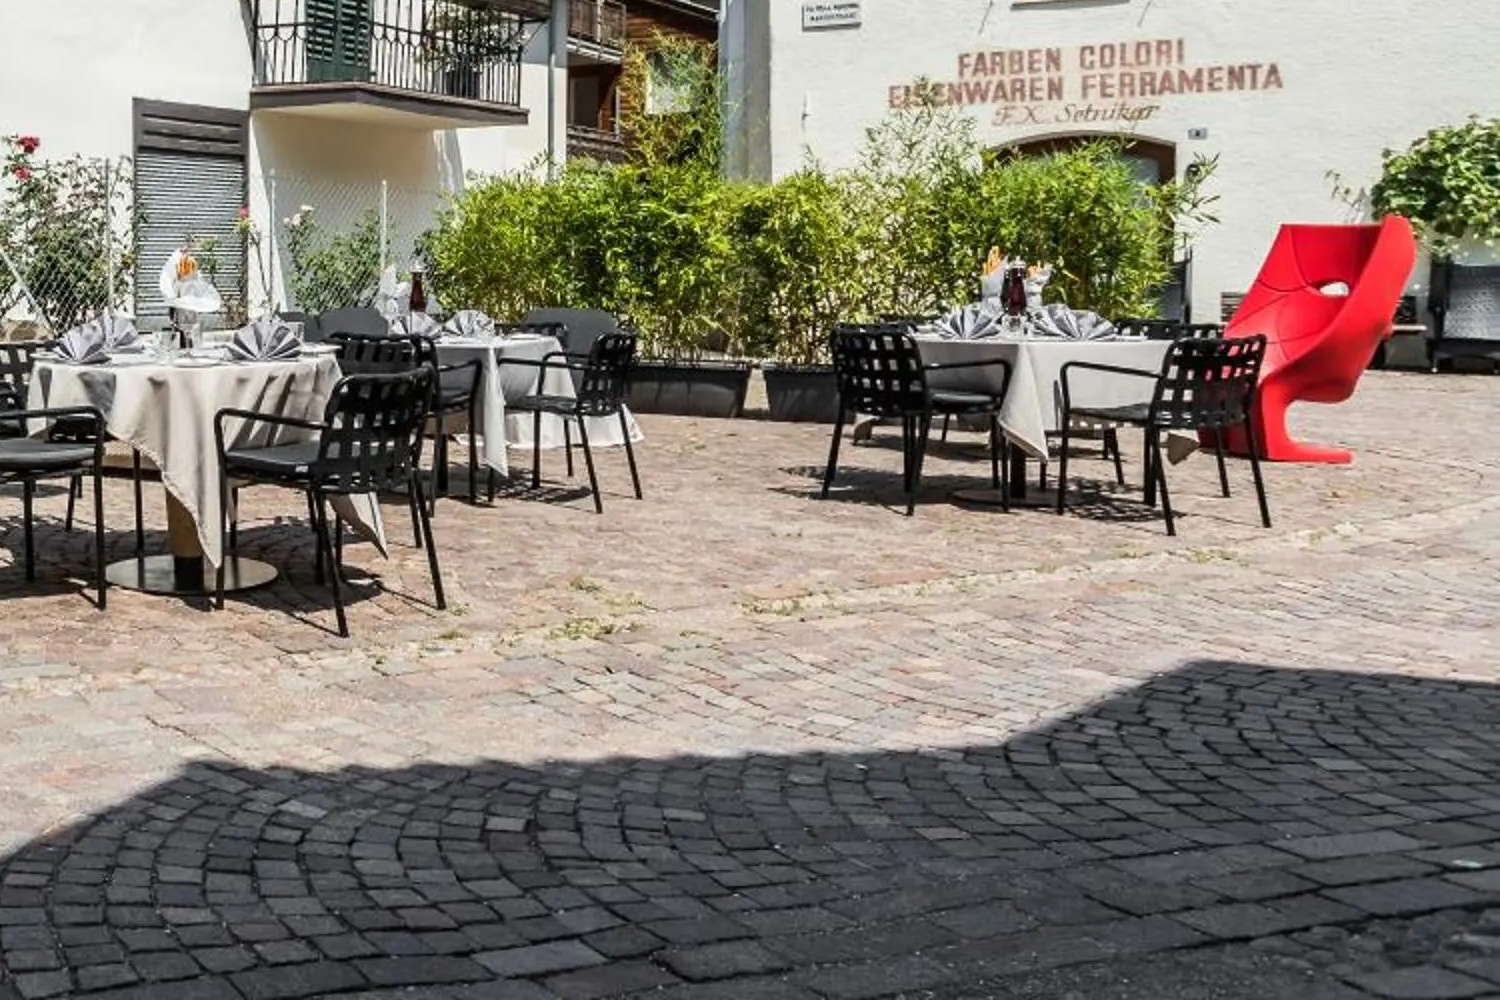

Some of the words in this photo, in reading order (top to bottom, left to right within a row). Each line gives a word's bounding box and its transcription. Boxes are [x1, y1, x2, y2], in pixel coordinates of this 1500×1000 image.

[957, 47, 1062, 78] FARBEN
[1079, 38, 1185, 70] COLORI
[1081, 63, 1284, 99] FERRAMENTA
